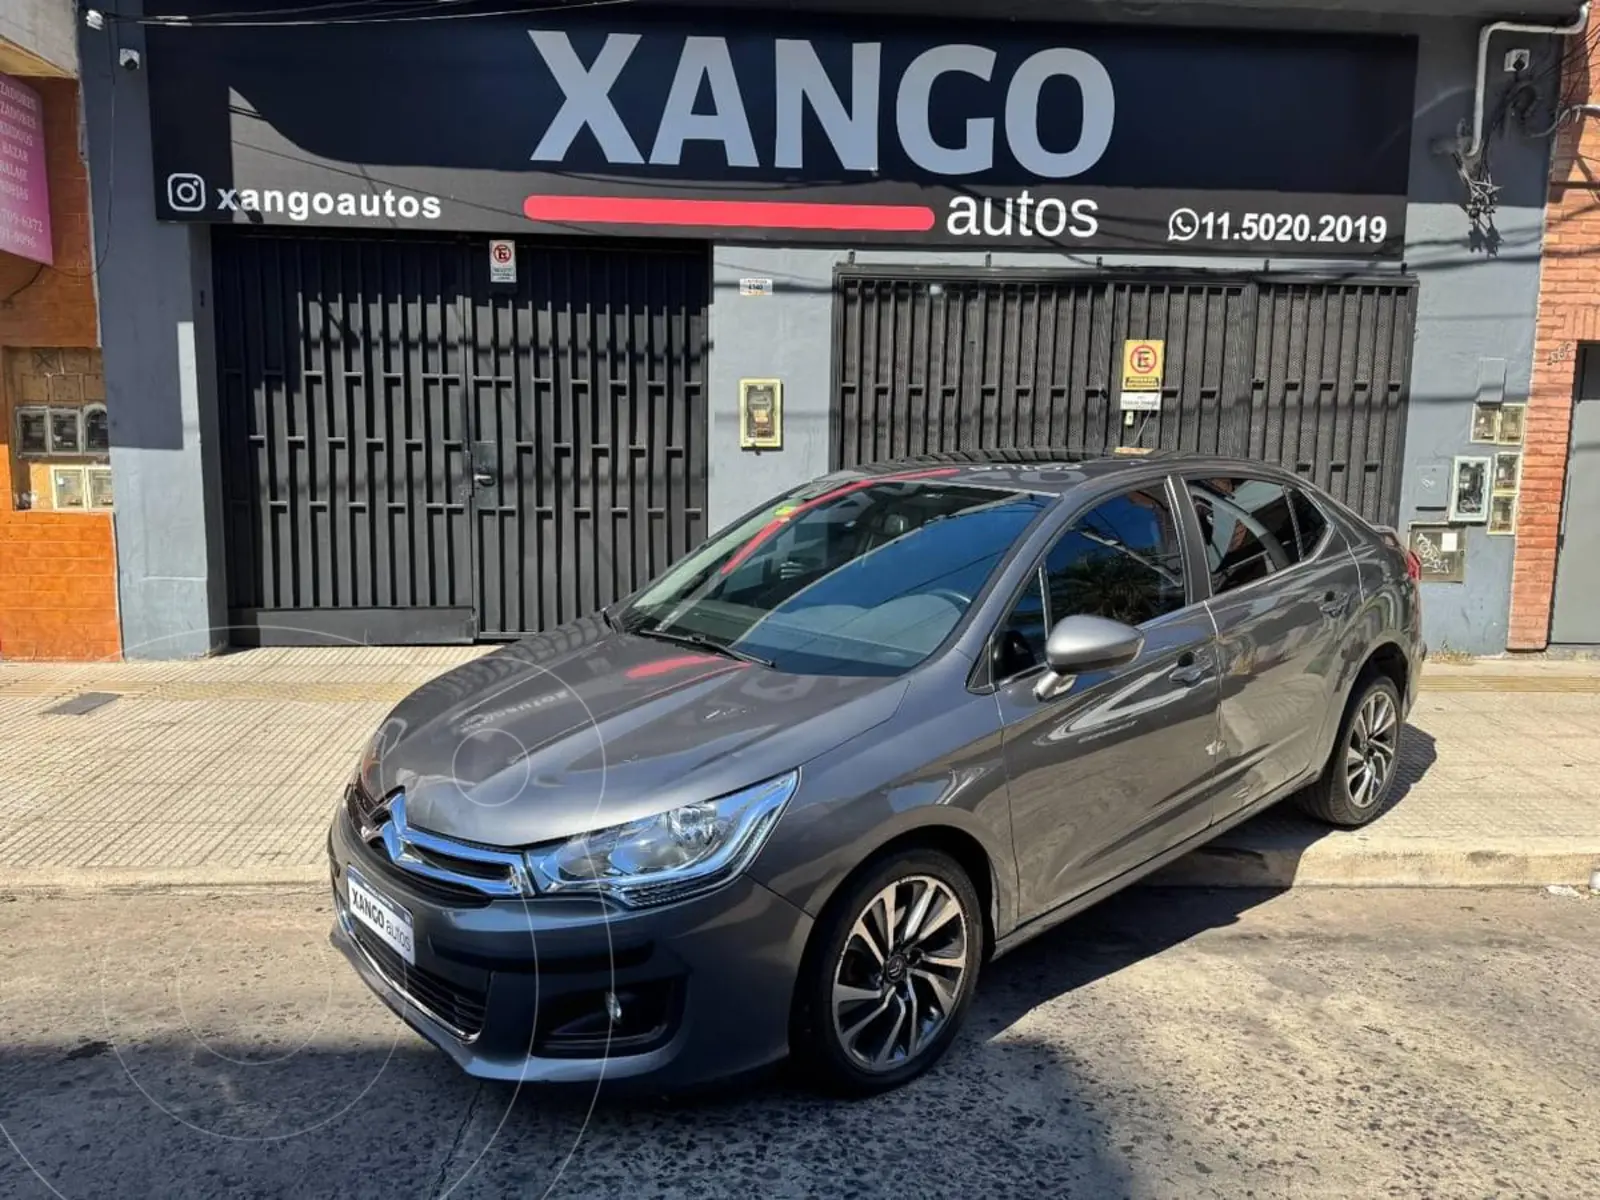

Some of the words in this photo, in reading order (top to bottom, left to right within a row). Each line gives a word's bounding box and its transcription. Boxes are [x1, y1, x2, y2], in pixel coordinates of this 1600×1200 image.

[528, 30, 1116, 179] XANGO
[217, 188, 441, 220] xangoautos
[946, 191, 1098, 237] autos
[1202, 212, 1387, 243] 11.5020.2019
[351, 888, 385, 929] XANGO
[386, 920, 412, 952] autos
